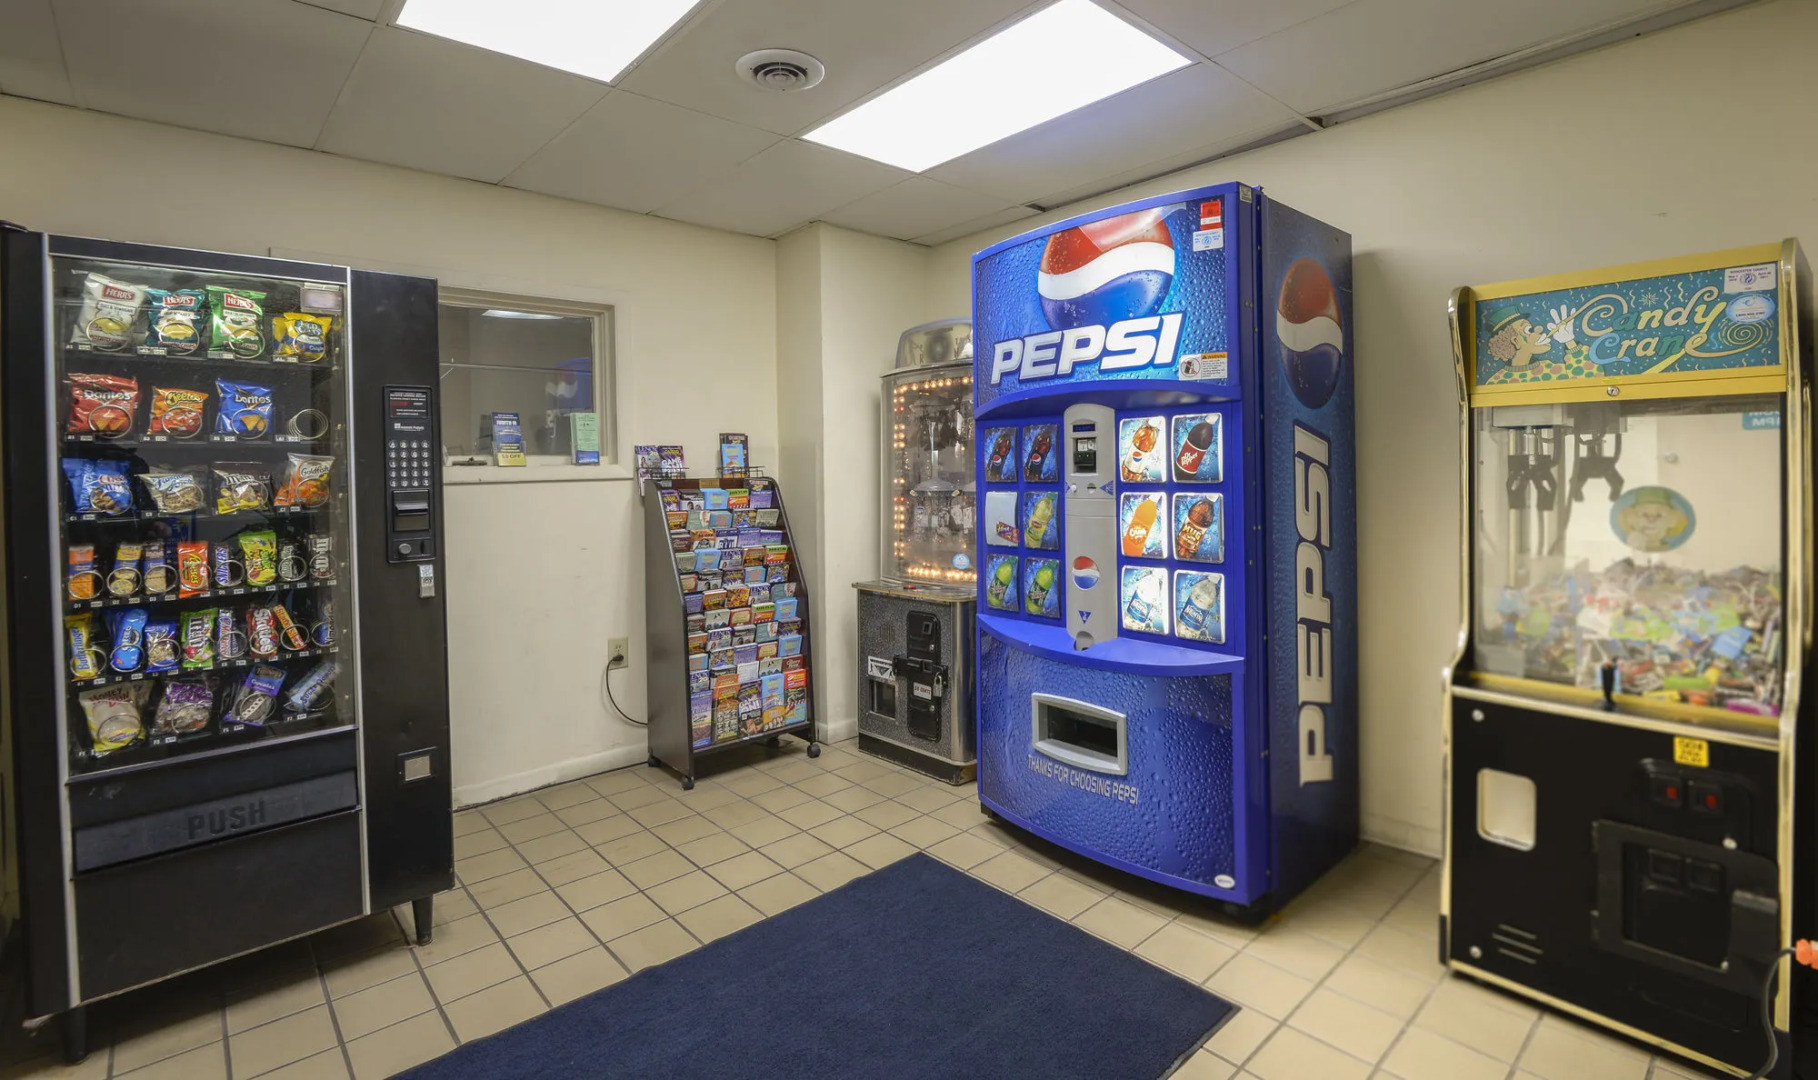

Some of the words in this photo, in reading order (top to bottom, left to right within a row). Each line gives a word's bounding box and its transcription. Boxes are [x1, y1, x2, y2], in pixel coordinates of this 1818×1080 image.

[1581, 285, 1728, 338] Candy
[990, 313, 1183, 386] PEPSI
[83, 389, 132, 401] Doritos
[234, 393, 272, 404] Doritos
[301, 466, 330, 477] Goldfish
[1294, 425, 1333, 788] PEPSI
[70, 626, 90, 670] Butterfinger
[1027, 754, 1053, 778] THANKS
[1054, 764, 1069, 784] FOR
[1070, 768, 1112, 798] CHOOSING
[1112, 783, 1139, 805] PEPSI
[187, 798, 266, 841] PUSH
